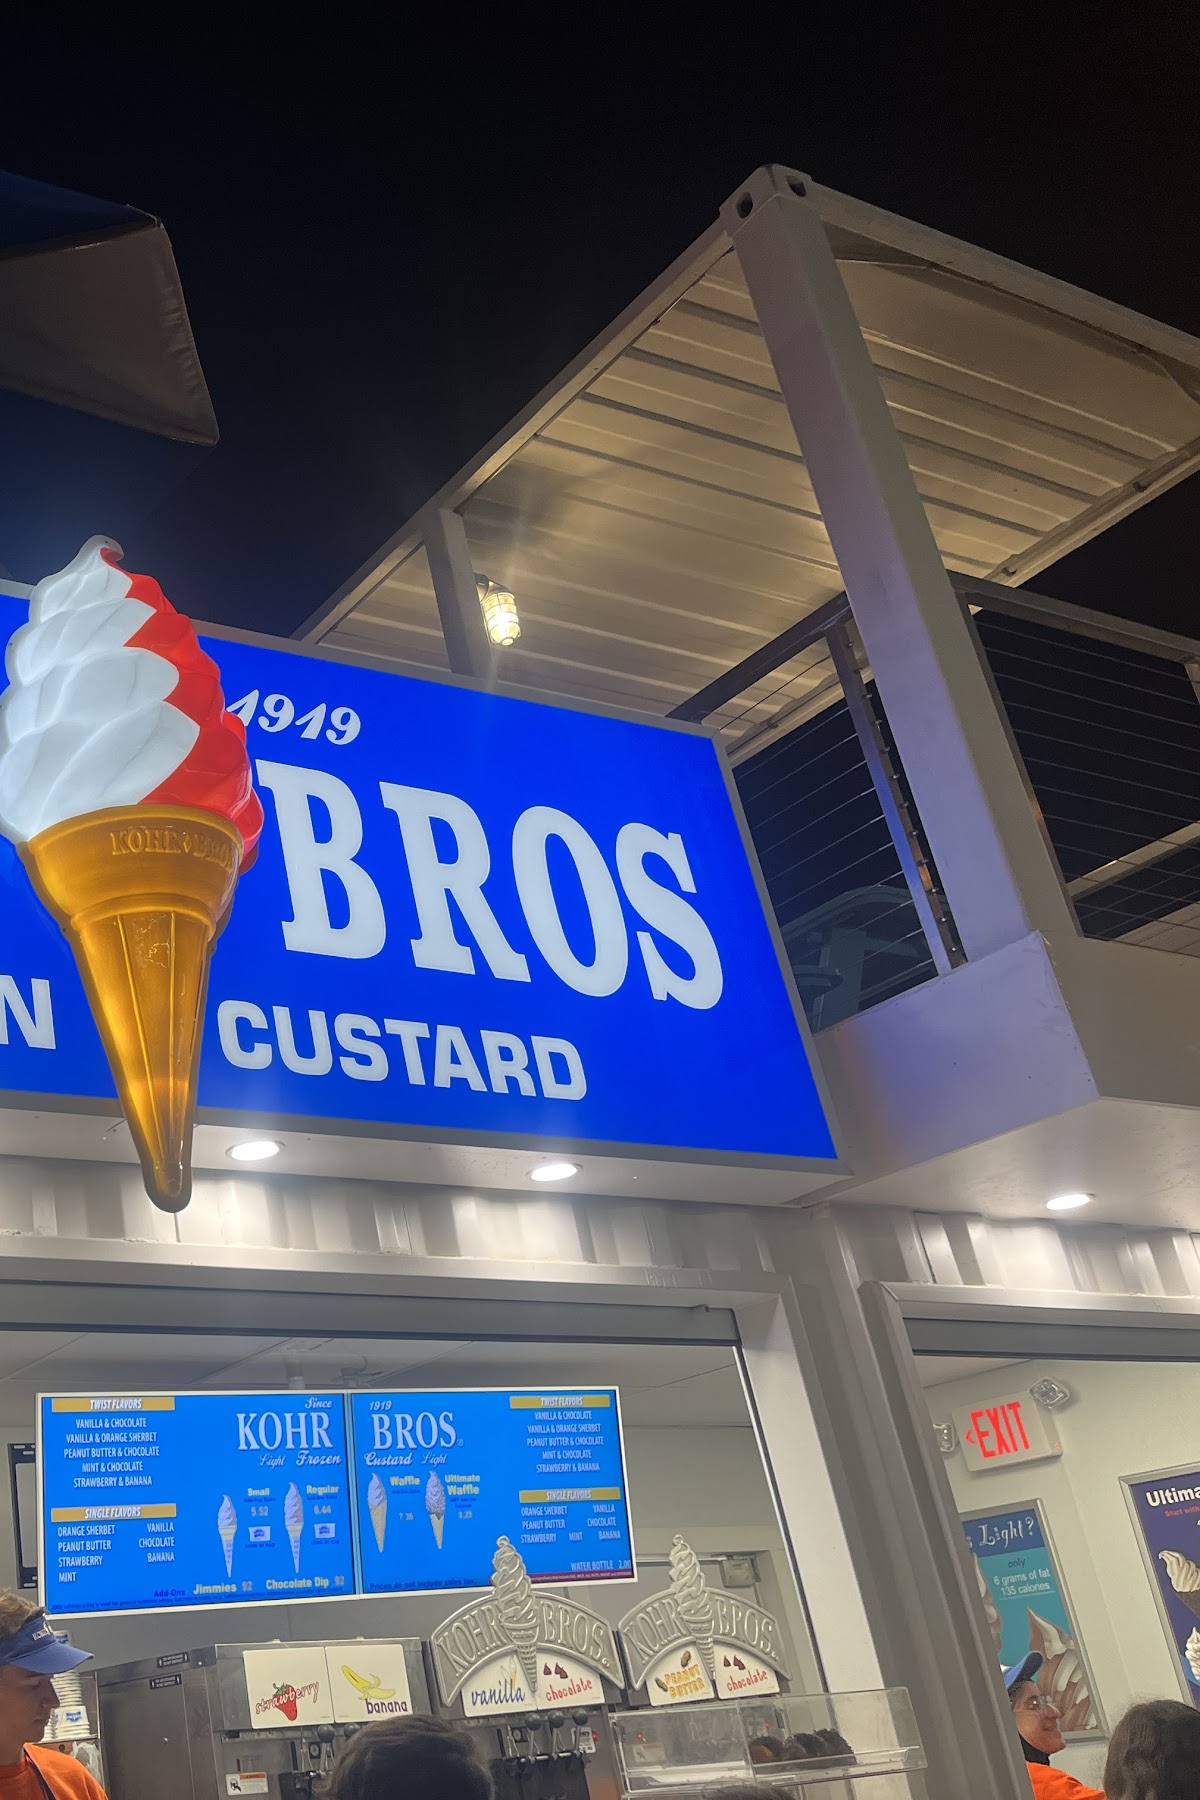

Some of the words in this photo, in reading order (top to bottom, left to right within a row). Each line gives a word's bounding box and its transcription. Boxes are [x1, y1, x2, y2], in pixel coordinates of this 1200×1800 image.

[227, 689, 361, 745] 1919
[109, 828, 182, 856] KOHR
[256, 758, 723, 1010] BROS
[217, 999, 587, 1101] CUSTARD
[90, 1399, 111, 1410] TWIST
[112, 1399, 142, 1410] FLAVORS
[304, 1396, 333, 1409] Since
[369, 1400, 392, 1411] 1919
[541, 1397, 558, 1406] TWIST
[559, 1396, 583, 1406] FLAVORS
[534, 1411, 557, 1420] VANILLA
[558, 1411, 562, 1420] &
[562, 1410, 592, 1420] CHOCOLATE
[75, 1418, 103, 1429] VANILLA
[104, 1418, 110, 1428] &
[111, 1417, 147, 1428] CHOCOLATE
[527, 1424, 551, 1434] VANILLA
[551, 1424, 556, 1433] &
[556, 1424, 578, 1433] ORANGE
[578, 1423, 601, 1432] SHERBET
[236, 1411, 333, 1451] KOHR
[969, 1400, 1032, 1459] EXIT
[66, 1433, 94, 1443] VANILLA
[94, 1433, 100, 1443] &
[101, 1432, 128, 1443] ORANGE
[129, 1431, 157, 1442] SHERBET
[526, 1438, 548, 1447] PEANUT
[548, 1437, 570, 1446] BUTTER
[570, 1437, 574, 1446] &
[574, 1436, 604, 1446] CHOCOLATE
[64, 1448, 90, 1458] PEANUT
[91, 1447, 117, 1458] BUTTER
[117, 1447, 123, 1457] &
[123, 1446, 160, 1457] CHOCOLATE
[295, 1450, 342, 1466] Frozen
[542, 1450, 557, 1460] MINT
[557, 1450, 562, 1459] &
[562, 1450, 592, 1459] CHOCOLATE
[363, 1452, 413, 1467] Custard
[81, 1462, 99, 1473] MINT
[100, 1462, 106, 1472] &
[106, 1461, 143, 1472] CHOCOLATE
[536, 1463, 572, 1473] STRAWBERRY
[572, 1463, 577, 1472] &
[577, 1462, 600, 1472] BANANA
[73, 1477, 117, 1488] STRAWBERRY
[118, 1476, 124, 1486] &
[124, 1475, 152, 1486] BANANA
[389, 1475, 421, 1486] Waffle
[444, 1474, 481, 1483] Ultimate
[247, 1487, 270, 1497] Small
[306, 1484, 339, 1496] Regular
[446, 1484, 480, 1496] Waffle
[546, 1490, 566, 1501] SINGLE
[567, 1489, 592, 1500] FLAVORS
[85, 1508, 111, 1519] SINGLE
[111, 1506, 141, 1518] FLAVORS
[520, 1506, 544, 1516] ORANGE
[544, 1506, 568, 1516] SHERBET
[592, 1504, 616, 1514] VANILLA
[1164, 1508, 1183, 1517] Start
[146, 1522, 174, 1533] VANILLA
[522, 1520, 544, 1530] PEANUT
[544, 1519, 566, 1529] BUTTER
[587, 1516, 616, 1527] CHOCOLATE
[57, 1525, 85, 1537] ORANGE
[86, 1524, 115, 1536] SHERBET
[568, 1532, 583, 1541] MINT
[598, 1530, 621, 1540] BANANA
[978, 1516, 1035, 1549] Light?
[138, 1537, 175, 1548] CHOCOLATE
[520, 1533, 557, 1544] STRAWBERRY
[58, 1541, 85, 1552] PEANUT
[86, 1540, 111, 1551] BUTTER
[58, 1555, 103, 1567] STRAWBERRY
[147, 1551, 175, 1563] BANANA
[1007, 1557, 1026, 1569] only
[570, 1561, 592, 1572] WATER
[592, 1560, 614, 1570] BOTTLE
[58, 1571, 77, 1582] MINT
[993, 1576, 1000, 1586] 6
[1001, 1573, 1027, 1587] grams
[1028, 1570, 1038, 1580] of
[1038, 1567, 1051, 1579] fat
[193, 1582, 238, 1595] Jimmies
[265, 1578, 312, 1590] Chocolate
[314, 1576, 330, 1588] Dip
[370, 1582, 392, 1590] Prices
[418, 1580, 442, 1588] include
[1000, 1585, 1017, 1596] 135
[1018, 1582, 1050, 1594] calories
[153, 1589, 186, 1598] Add-Ons
[623, 1599, 687, 1665] KOHR
[437, 1604, 507, 1678] KOHR
[664, 1663, 701, 1686] PEANUT
[726, 1668, 768, 1692] chocolate
[471, 1677, 526, 1707] vanilla
[545, 1676, 593, 1702] chocolate
[668, 1677, 705, 1699] BUTTER
[255, 1681, 320, 1715] strawberry
[365, 1698, 408, 1715] banana
